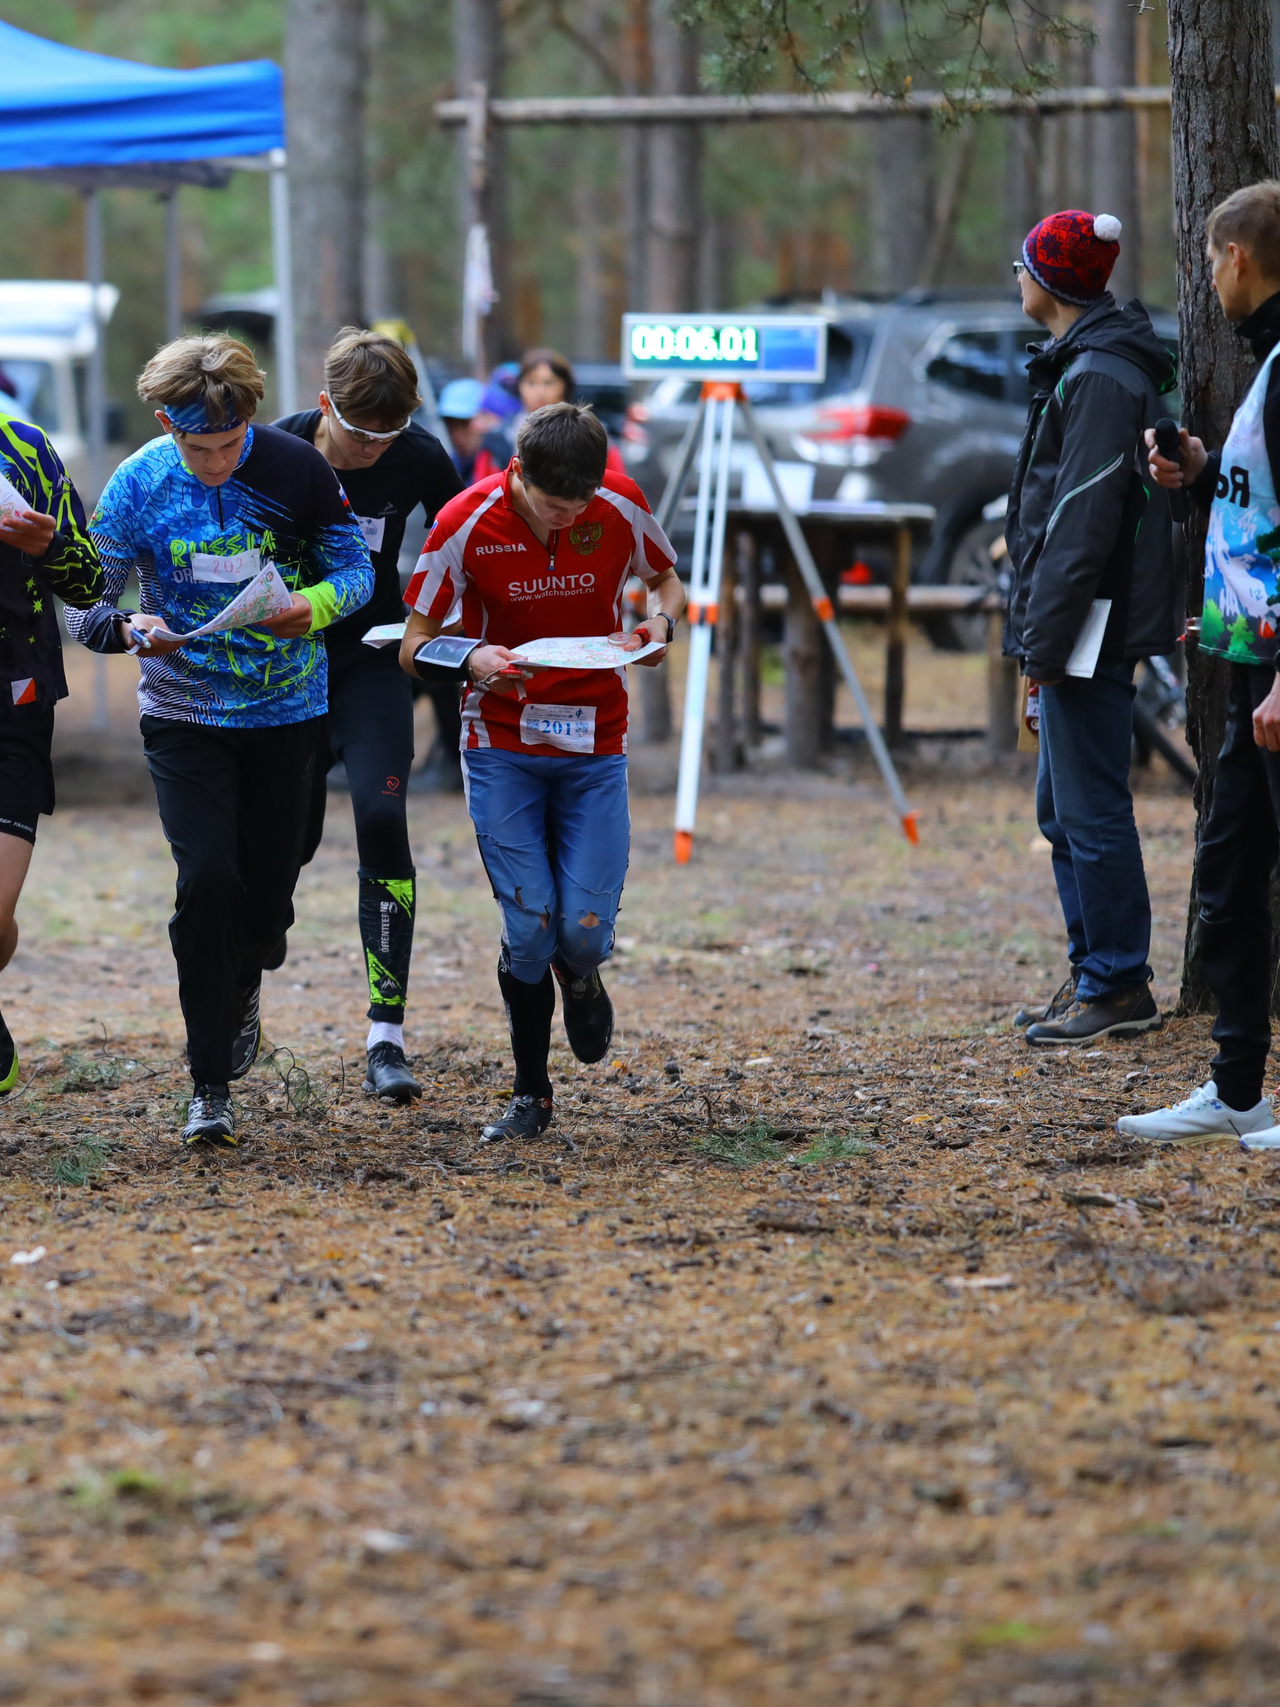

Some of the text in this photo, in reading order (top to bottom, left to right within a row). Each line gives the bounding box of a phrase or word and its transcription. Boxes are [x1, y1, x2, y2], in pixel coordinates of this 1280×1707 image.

[474, 542, 528, 556] RUSSIA
[213, 557, 243, 574] 202
[508, 572, 596, 598] SUUNTO
[510, 586, 595, 603] www.watchsport.ru
[542, 719, 571, 736] 201
